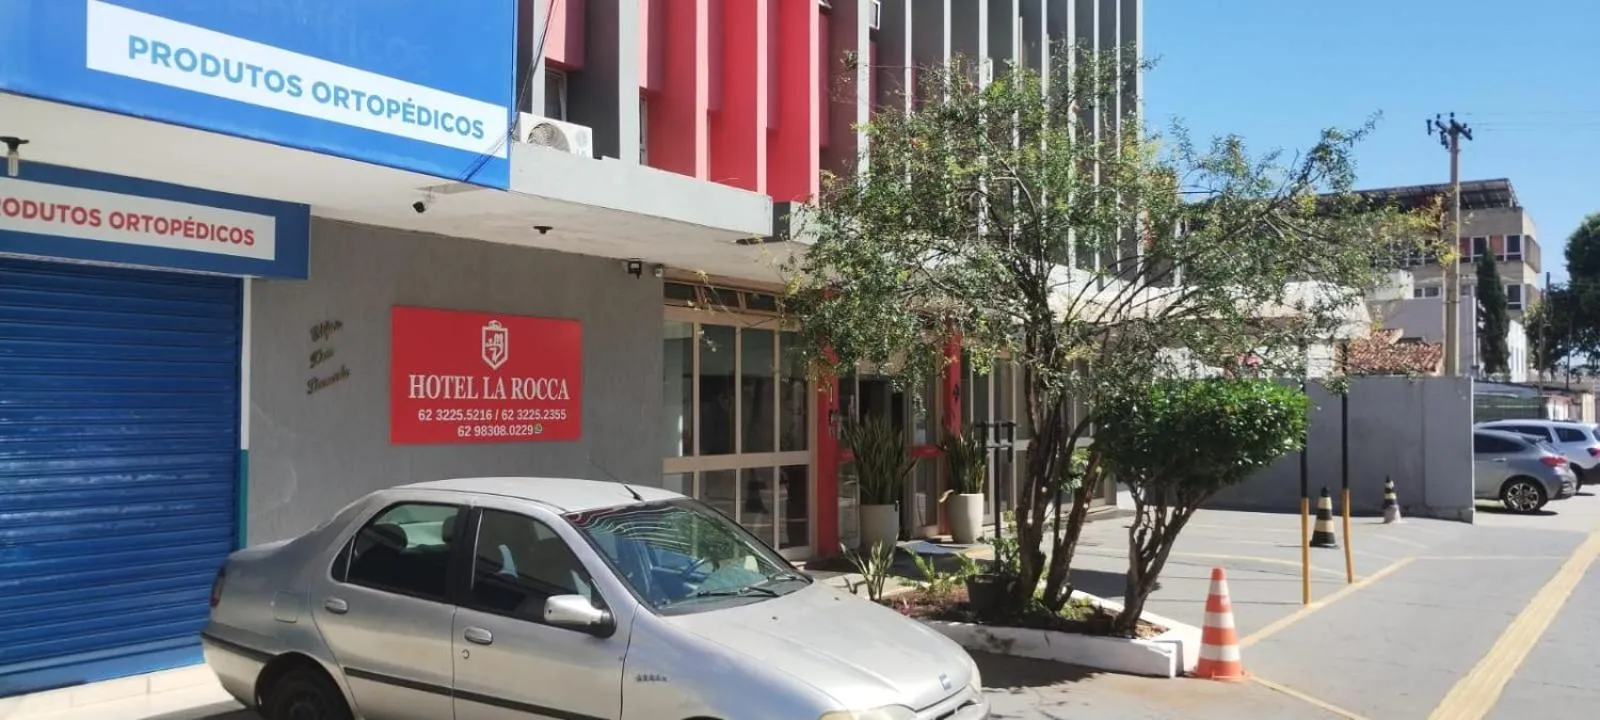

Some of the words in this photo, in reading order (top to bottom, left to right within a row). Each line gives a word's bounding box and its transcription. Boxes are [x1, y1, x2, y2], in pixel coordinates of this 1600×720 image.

[128, 34, 303, 98] PRODUTOS
[312, 81, 485, 140] ORTOPÉDICOS
[0, 197, 102, 228] ODUTOS
[109, 211, 255, 247] ORTOPÉDICOS
[408, 374, 478, 399] HOTEL
[483, 376, 506, 400] LA
[511, 377, 570, 400] ROCCA
[418, 409, 432, 421] 62
[436, 409, 493, 421] 3225.5216
[501, 409, 514, 421] 62
[517, 409, 567, 420] 3225.2355
[457, 425, 471, 437] 62
[474, 424, 533, 436] 98308.0229
